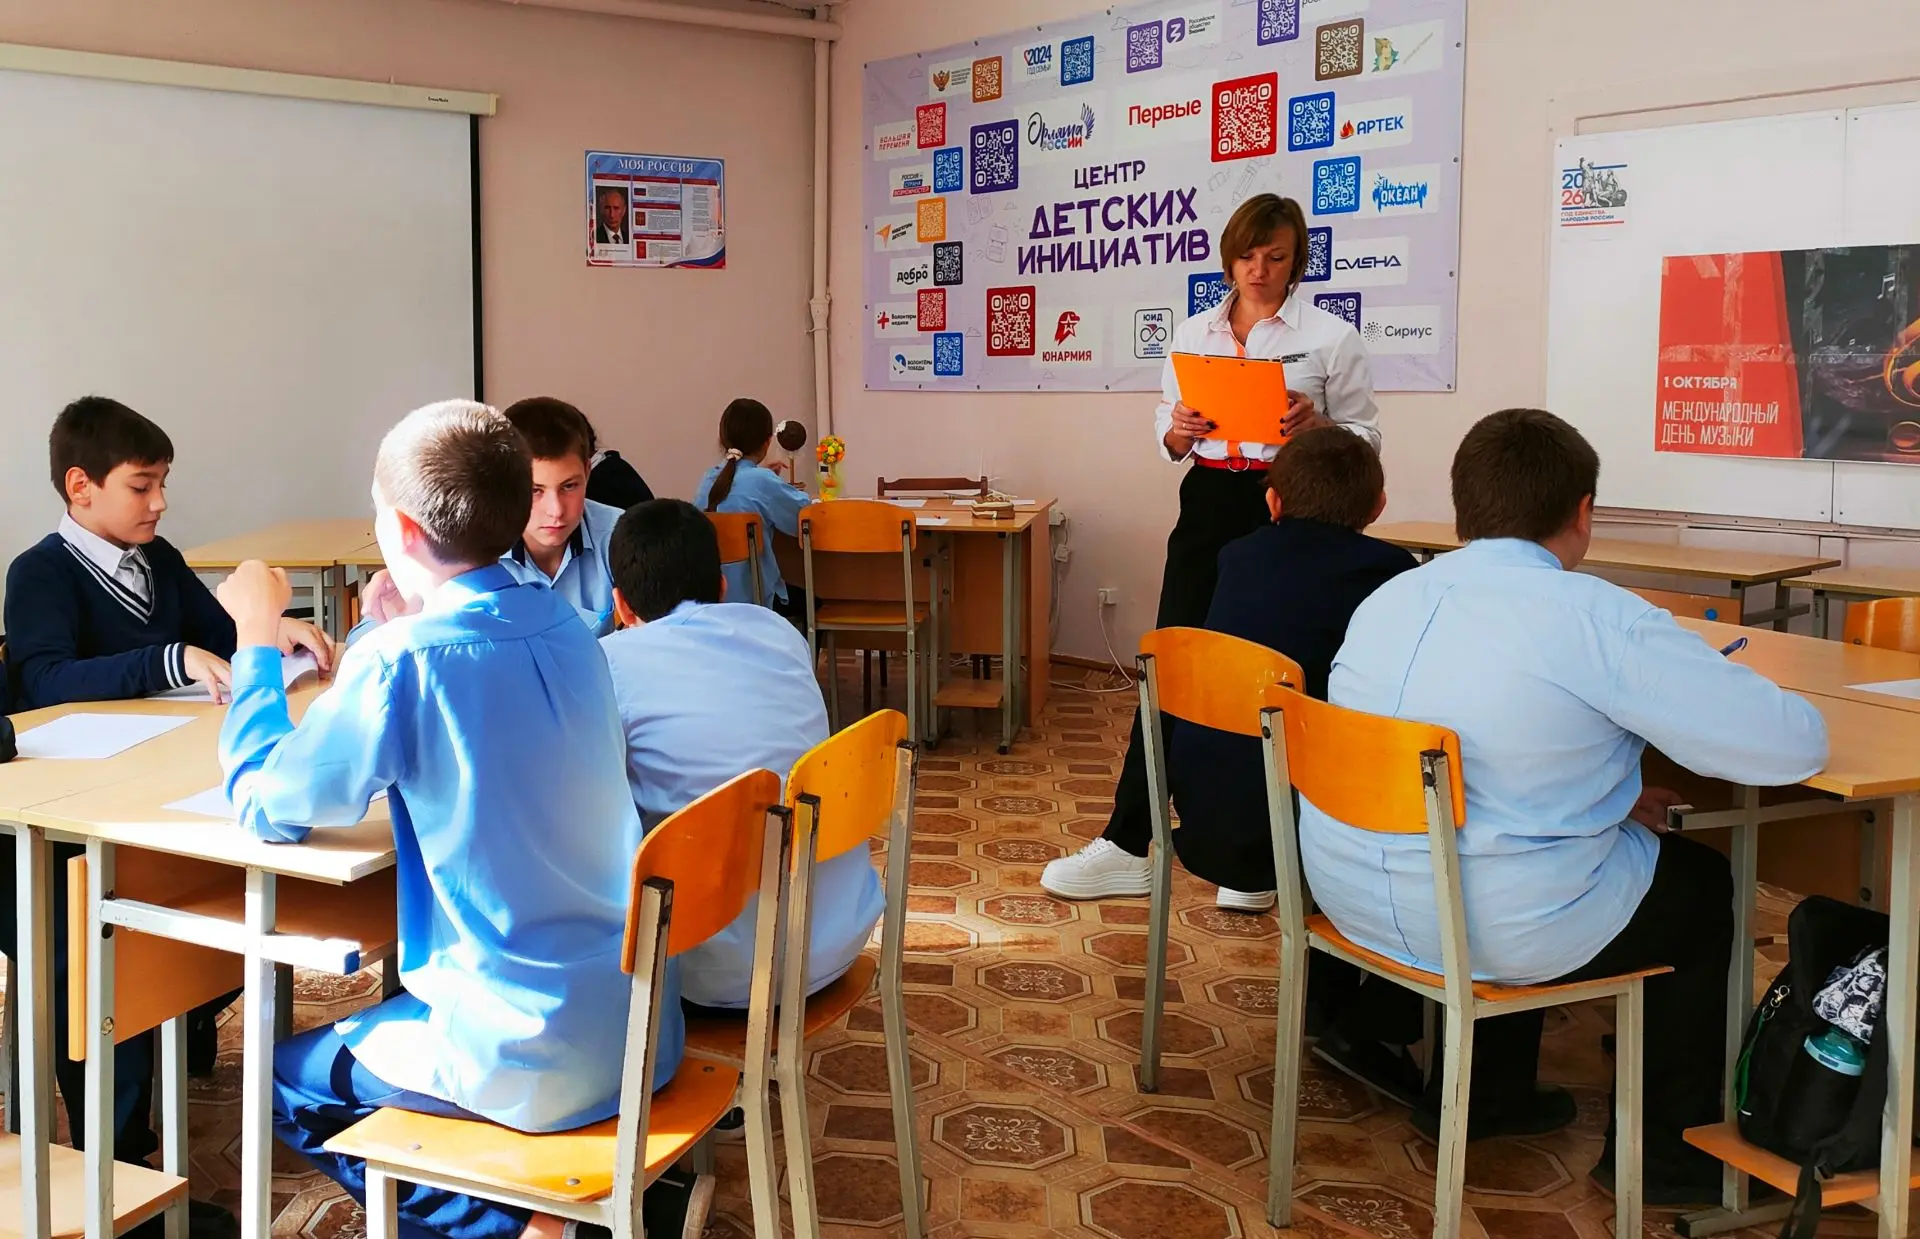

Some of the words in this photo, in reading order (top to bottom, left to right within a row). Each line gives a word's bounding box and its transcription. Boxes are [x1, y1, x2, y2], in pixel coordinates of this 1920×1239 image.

[1027, 45, 1052, 66] 2024
[1128, 99, 1202, 128] Первые
[1028, 112, 1083, 148] Орлята
[1357, 115, 1404, 135] АРТЕК
[618, 159, 644, 170] МОЯ
[648, 160, 694, 173] РОССИЯ
[1074, 160, 1146, 190] ЦЕНТР
[1562, 173, 1584, 189] 20
[1381, 187, 1418, 203] ОКЕАН
[1562, 190, 1584, 206] 26
[1029, 186, 1198, 239] ДЕТСКИХ
[1018, 229, 1210, 275] ИНИЦИАТИВ
[1335, 255, 1402, 270] СМЕНА
[897, 267, 928, 283] добро
[1143, 313, 1163, 322] ЮИД
[1384, 325, 1432, 338] Сириус
[1042, 350, 1092, 362] ЮНАРМИЯ
[1664, 376, 1669, 388] 1
[1672, 376, 1738, 389] ОКТЯБРЯ
[1662, 400, 1779, 424] МЕЖДУНАРОДНЫЙ
[1661, 423, 1696, 445] ДЕНЬ
[1700, 425, 1754, 447] МУЗЫКИ
